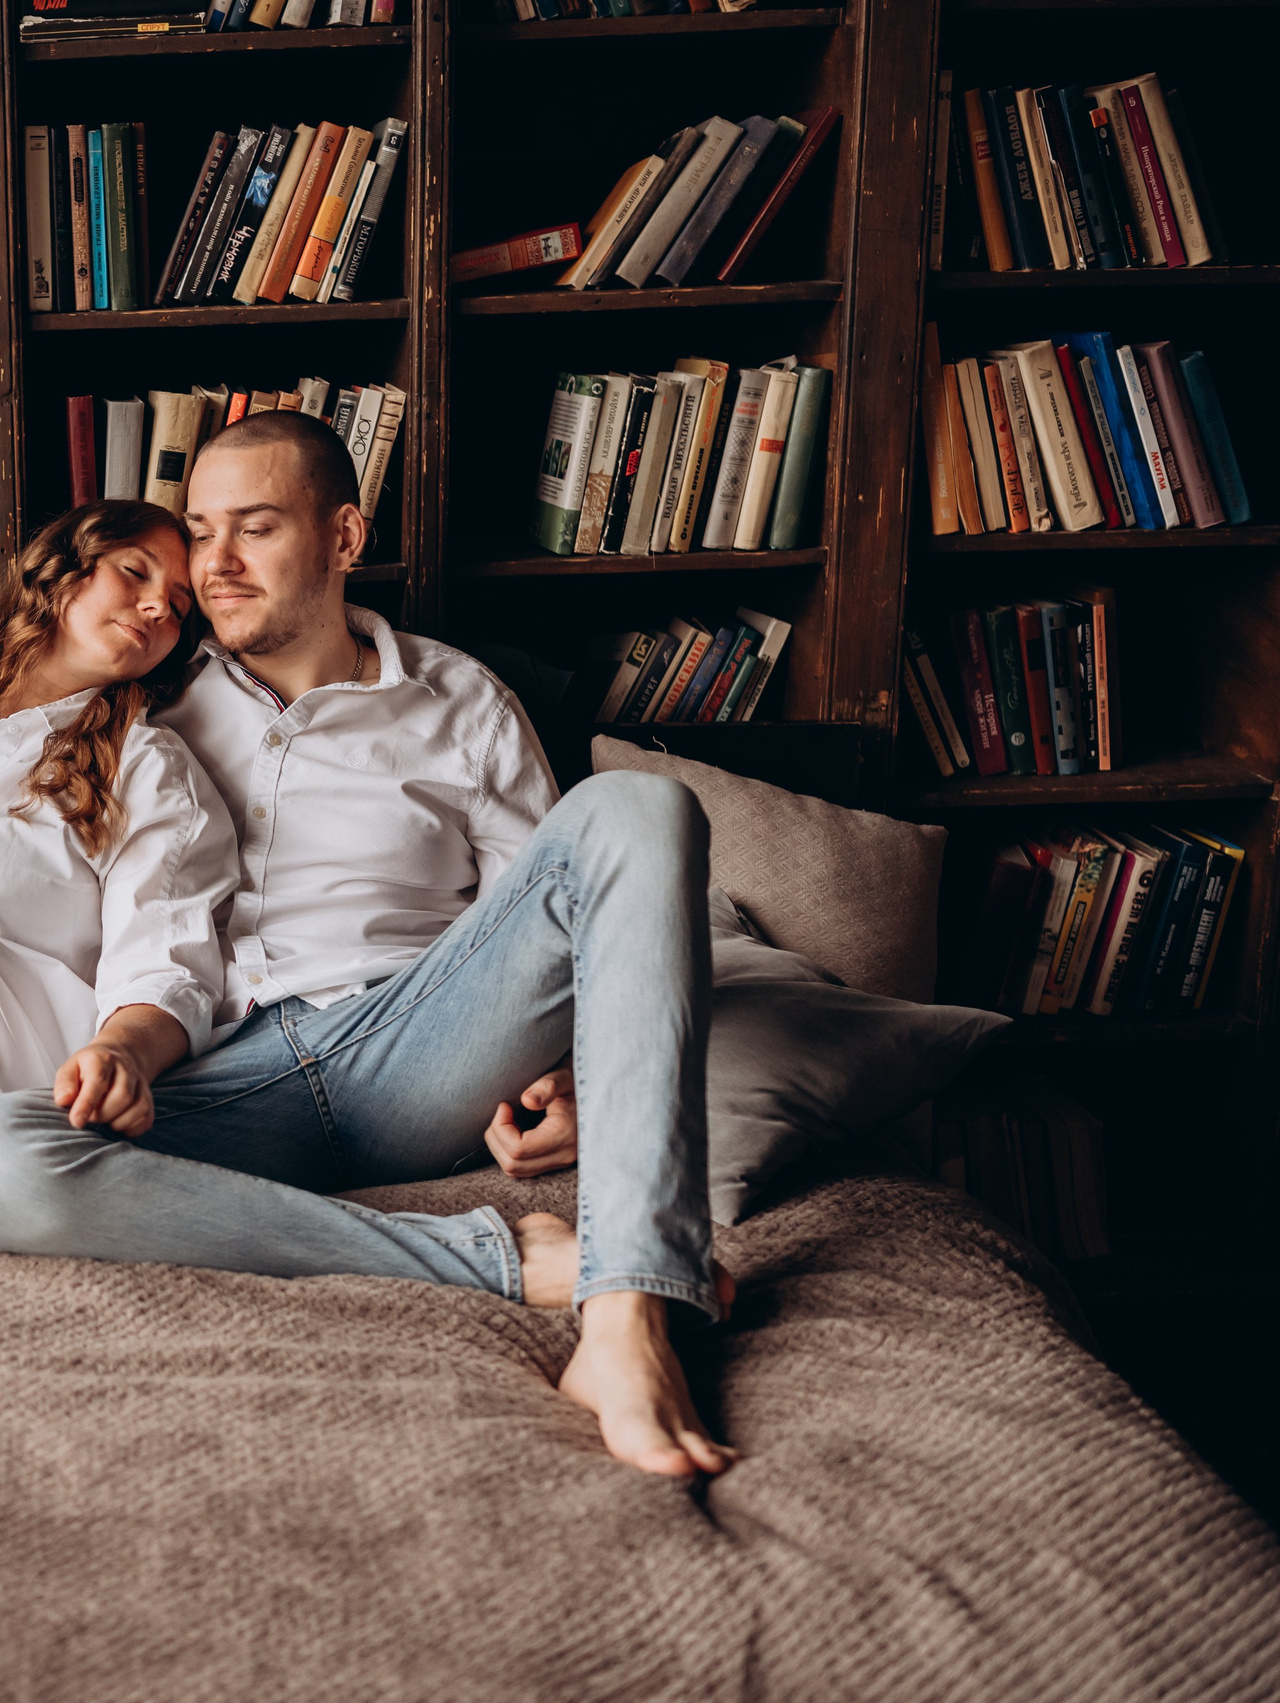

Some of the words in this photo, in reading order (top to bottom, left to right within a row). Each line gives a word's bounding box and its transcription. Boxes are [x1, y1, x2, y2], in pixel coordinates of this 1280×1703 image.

[140, 23, 166, 31] СПРУТ
[1004, 103, 1024, 157] ЛОНДОН
[1108, 96, 1127, 140] СВАДЕБНЫЙ
[136, 143, 144, 183] БУРЦЕВ
[262, 131, 283, 164] ЛУКЬЯНЕНКО
[350, 136, 365, 161] Татьяна
[1119, 142, 1132, 166] МАРШ
[114, 139, 125, 209] ПРОИСХОЖДЕНИЕ
[336, 160, 356, 198] Соломатина
[681, 144, 717, 193] ПЕРМЯК
[1015, 160, 1033, 201] ДЖЕК
[1167, 150, 1185, 190] АРКАДИЙ
[1178, 192, 1194, 225] ГАЙДАР
[614, 186, 642, 225] АЛЕКСАНДР
[638, 168, 653, 187] БЛОК
[1125, 167, 1147, 222] МЕНДЕЛЬСОНА
[1140, 145, 1161, 200] Императорский
[1155, 200, 1165, 214] Рим
[1161, 221, 1172, 242] лицах
[94, 222, 102, 246] ГРАЧИ
[117, 211, 127, 252] МАСТЕРА
[189, 250, 212, 295] Американская
[204, 200, 230, 251] фантастическая
[223, 182, 236, 202] проза
[343, 225, 371, 285] М.ГОРЬКИЙ
[1137, 365, 1155, 400] Сталина
[351, 414, 372, 457] ОЖОГ
[670, 393, 696, 471] МИХАЛЬСКИЙ
[575, 445, 589, 484] ЗОЛОТОМ
[582, 429, 592, 445] УСЕ
[1162, 449, 1182, 489] Исповедь
[662, 476, 679, 519] ВАЦЛАВ
[936, 462, 948, 497] Болезни
[683, 493, 695, 524] ПЕРВЫХ
[973, 688, 983, 714] моей
[981, 692, 1000, 736] История
[977, 715, 990, 749] жизни
[1136, 866, 1156, 890] 6
[1127, 889, 1148, 920] ЧЕЙЗ
[1115, 919, 1140, 957] ХЭДЛИ
[1100, 956, 1128, 1004] ДЖЕЙМС
